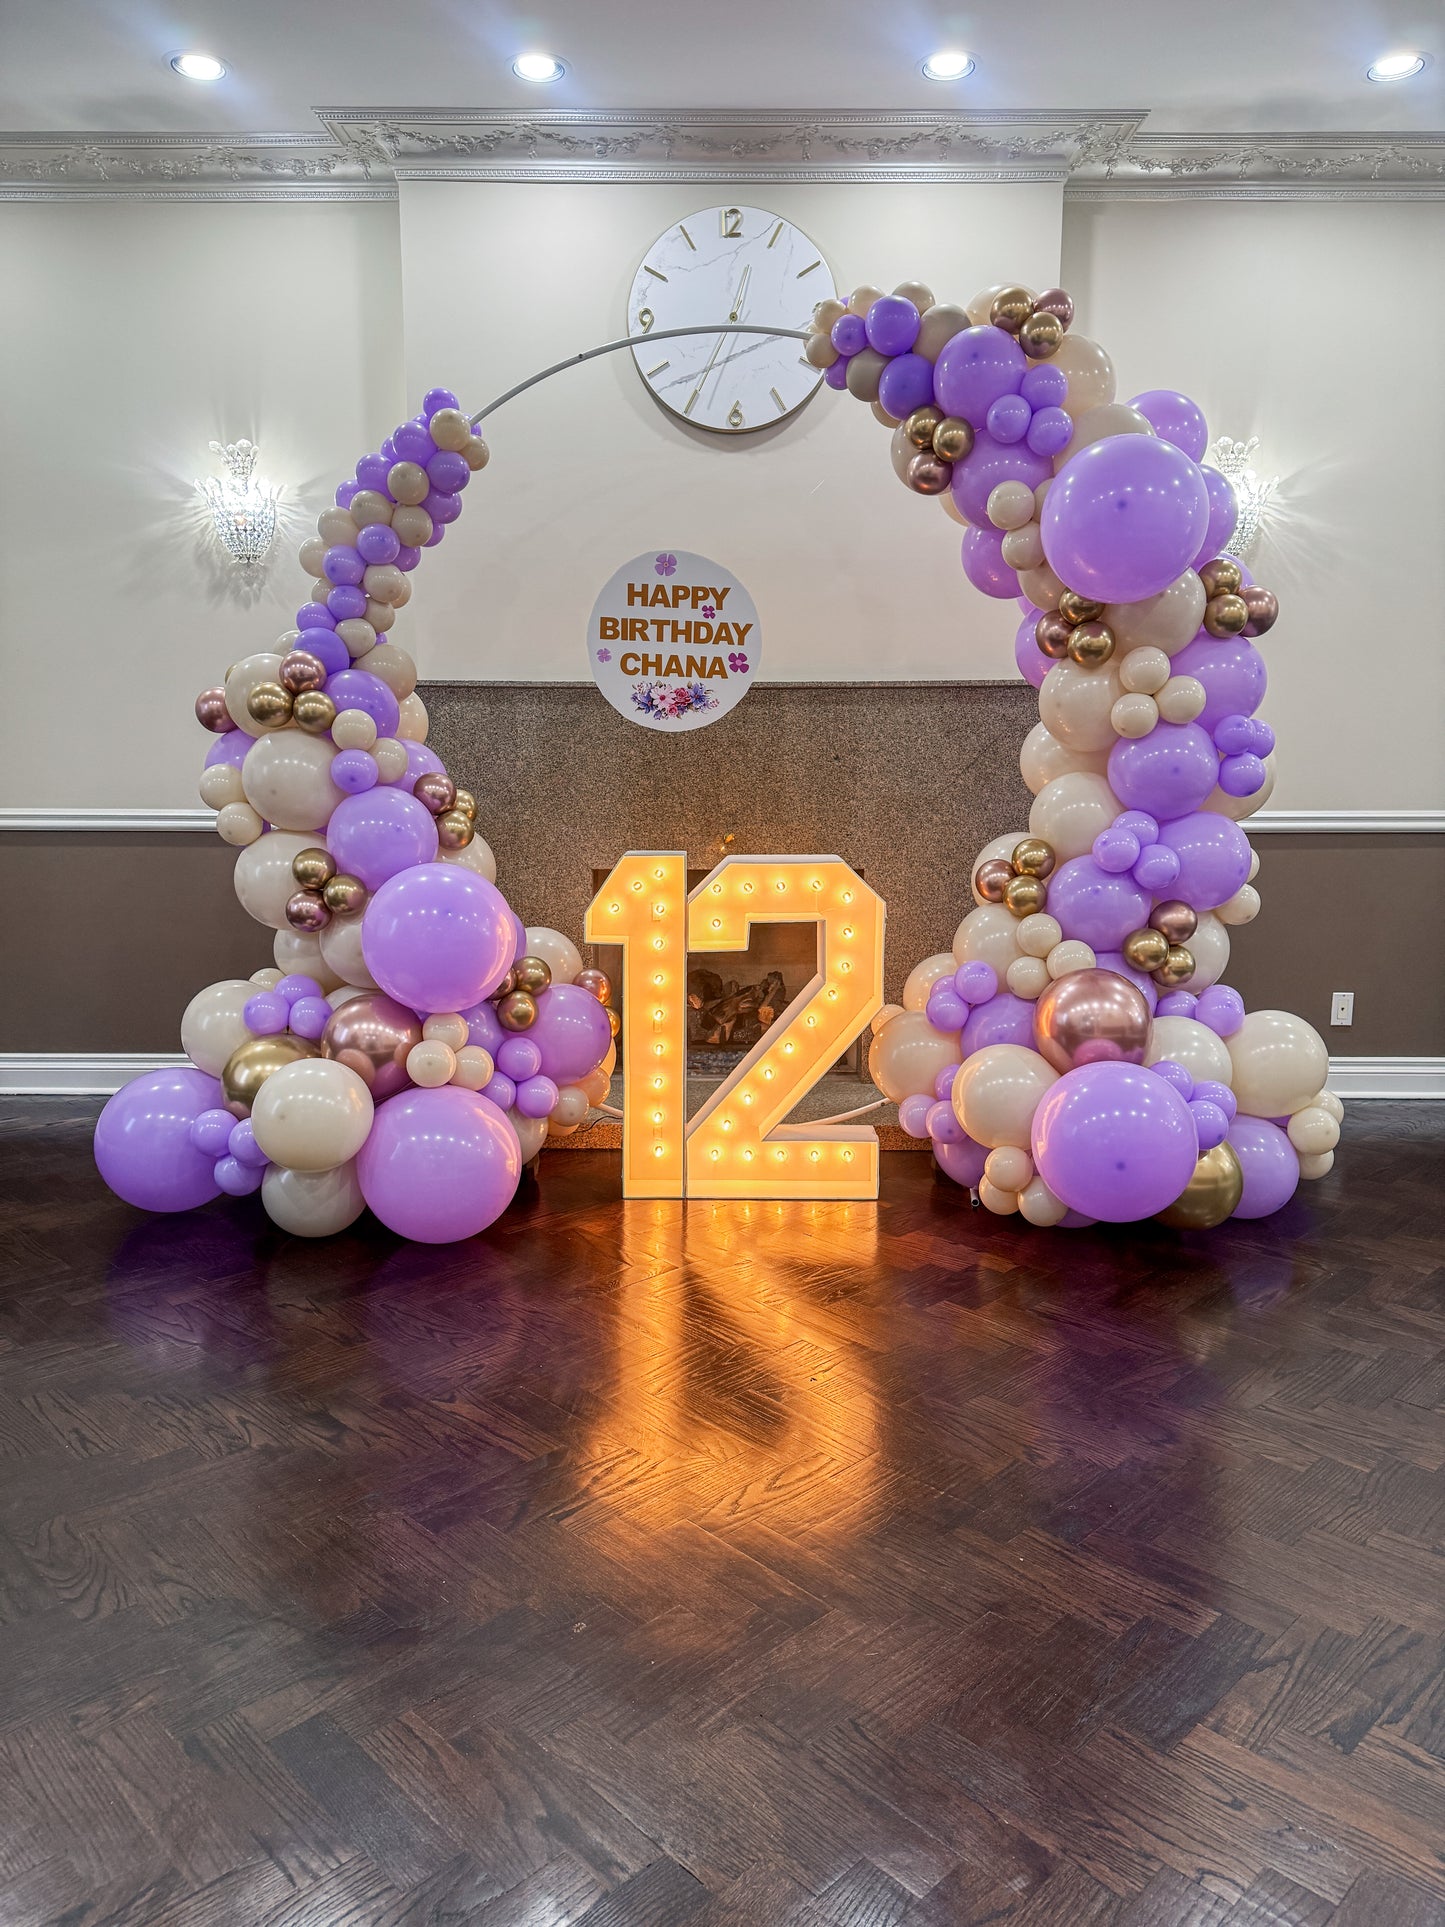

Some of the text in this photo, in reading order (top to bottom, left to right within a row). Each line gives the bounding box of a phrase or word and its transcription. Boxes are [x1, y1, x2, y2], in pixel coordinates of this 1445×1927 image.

[720, 208, 743, 238] 12
[638, 307, 654, 334] 9
[728, 400, 743, 426] 6
[627, 583, 731, 611] HAPPY
[599, 616, 753, 646] BIRTHDAY
[619, 652, 729, 679] CHANA
[583, 850, 887, 1200] 12
